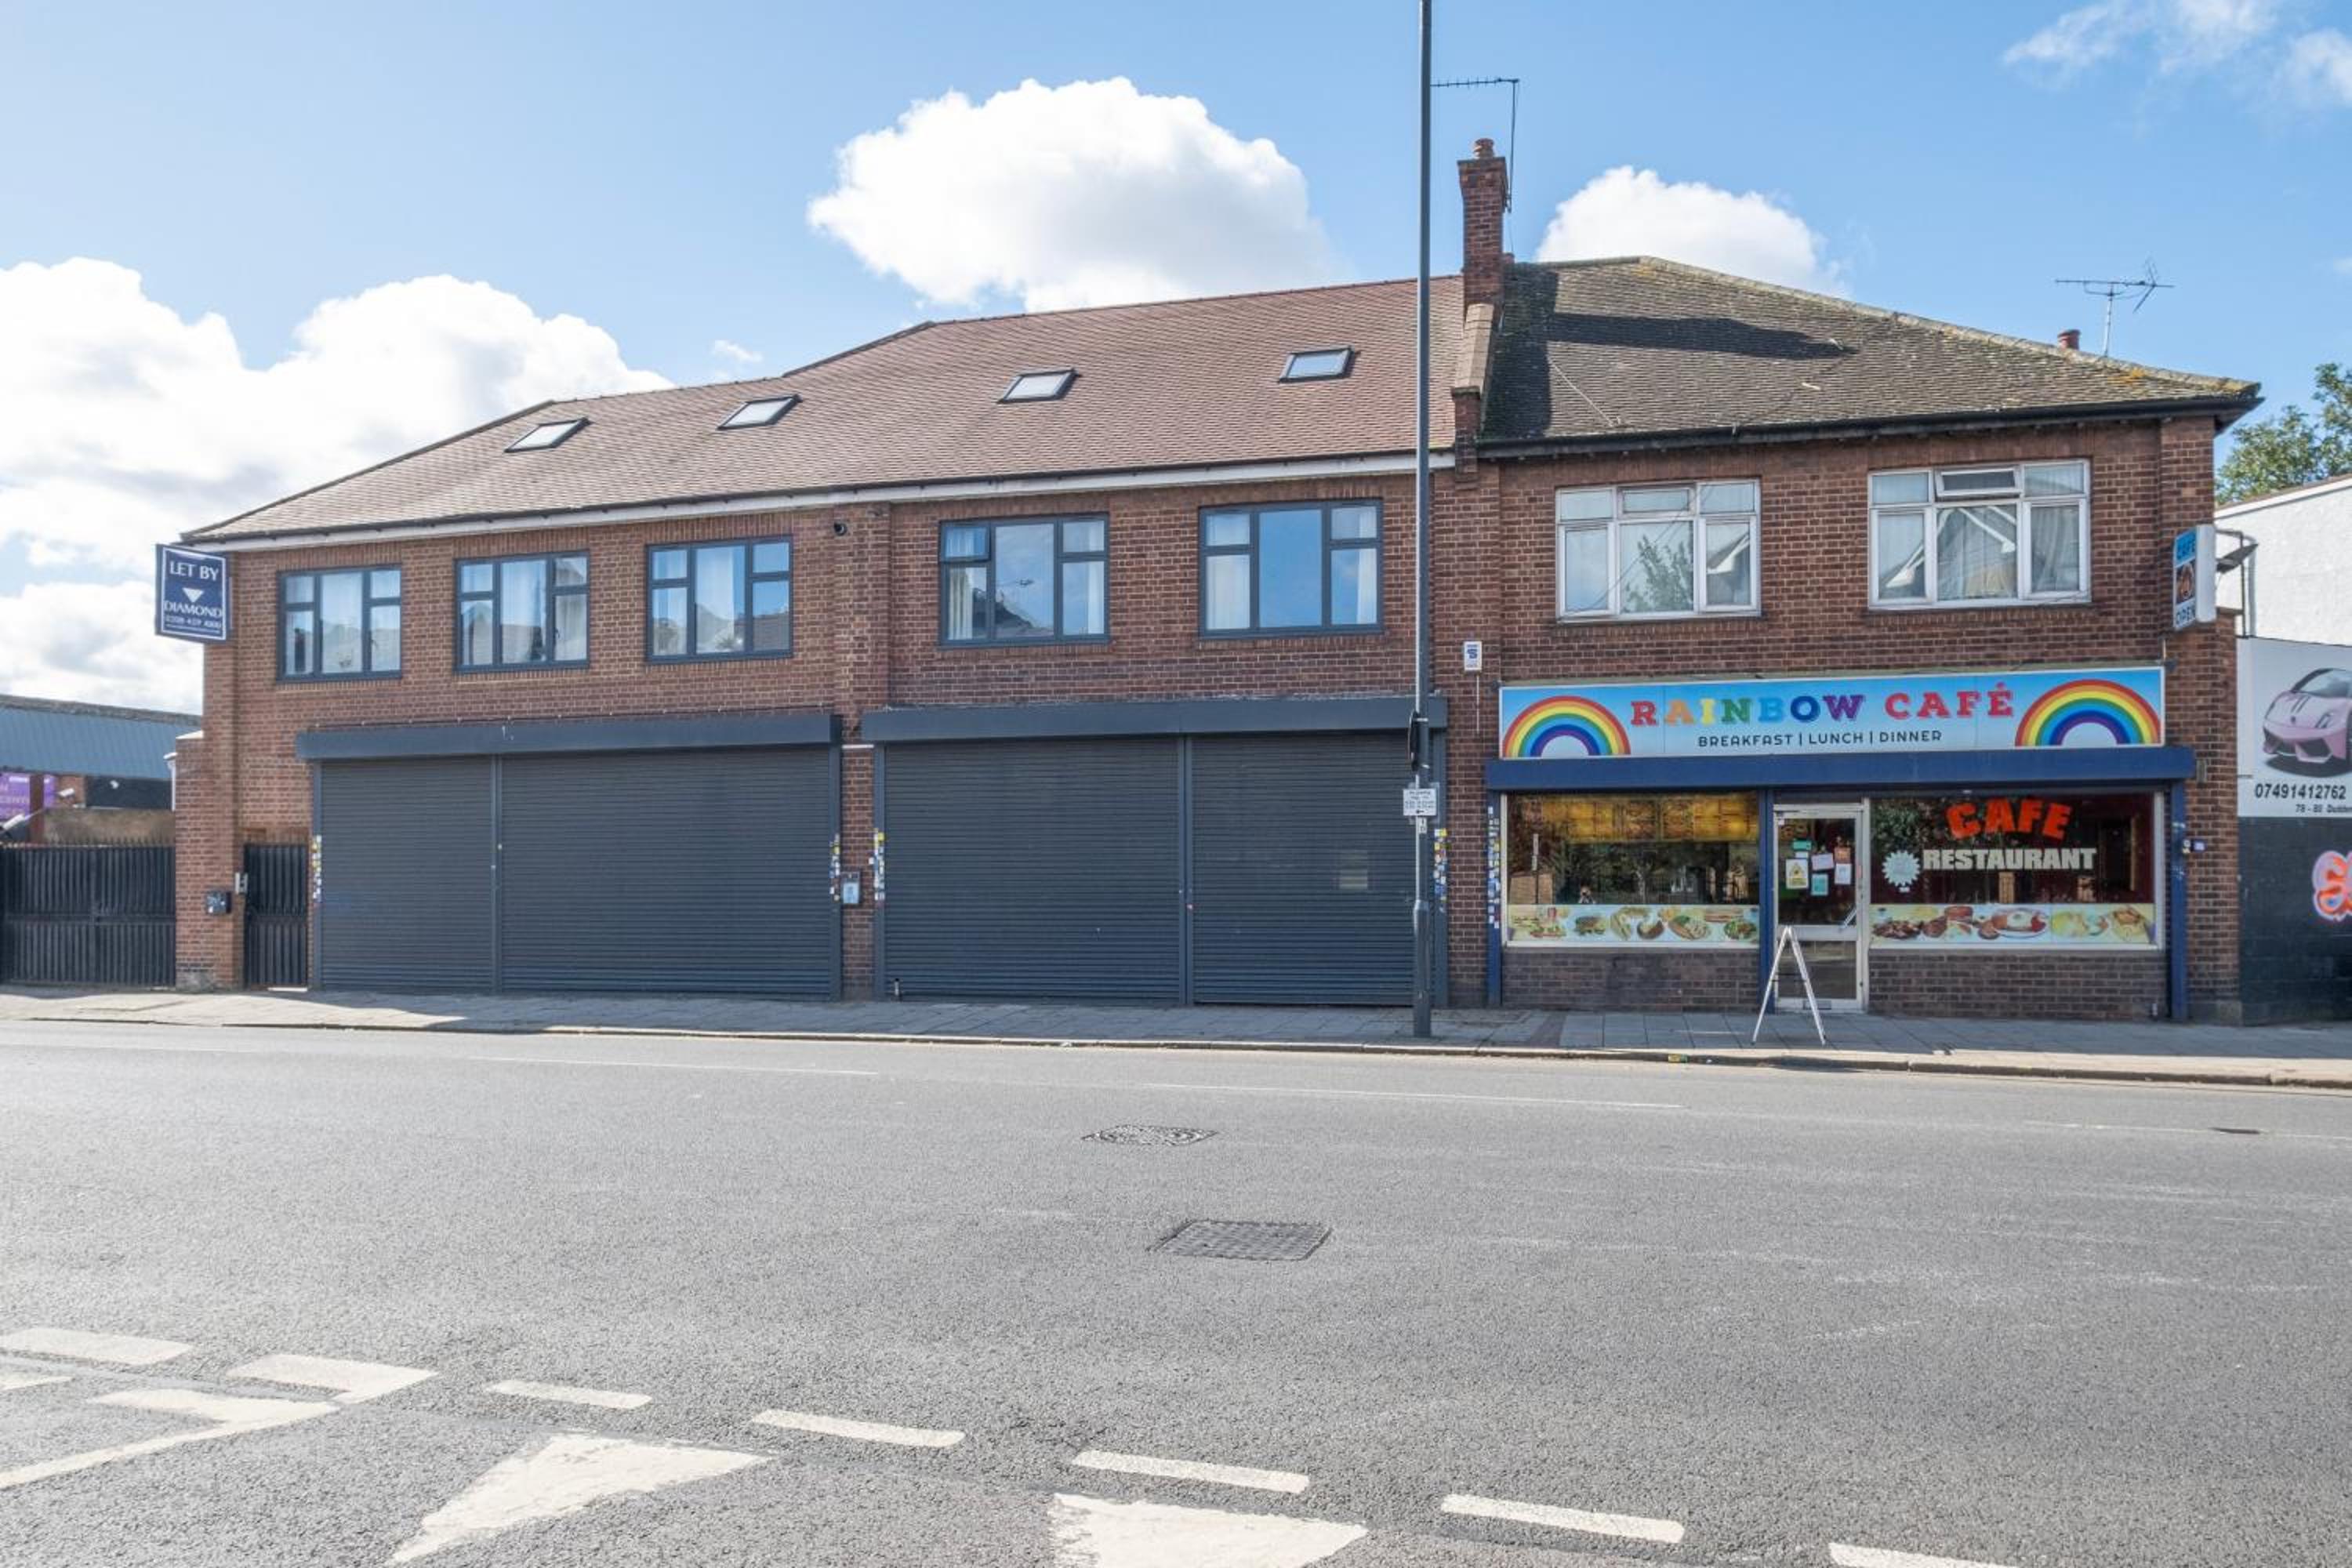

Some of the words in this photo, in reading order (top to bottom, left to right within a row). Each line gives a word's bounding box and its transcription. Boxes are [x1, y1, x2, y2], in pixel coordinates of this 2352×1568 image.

[170, 561, 196, 577] LET
[200, 566, 220, 581] BY
[164, 601, 223, 619] DIAMOND
[2176, 601, 2196, 626] OPEN
[1631, 694, 1865, 727] RAINBOW
[1884, 682, 2014, 720] CAFÉ
[1697, 734, 1794, 747] BREAKFAST
[1809, 732, 1864, 745] LUNCH
[1879, 731, 1942, 742] DINNER
[2255, 783, 2347, 800] 07491412762
[1947, 798, 2072, 840] CAFE
[1922, 848, 2097, 870] RESTAURANT
